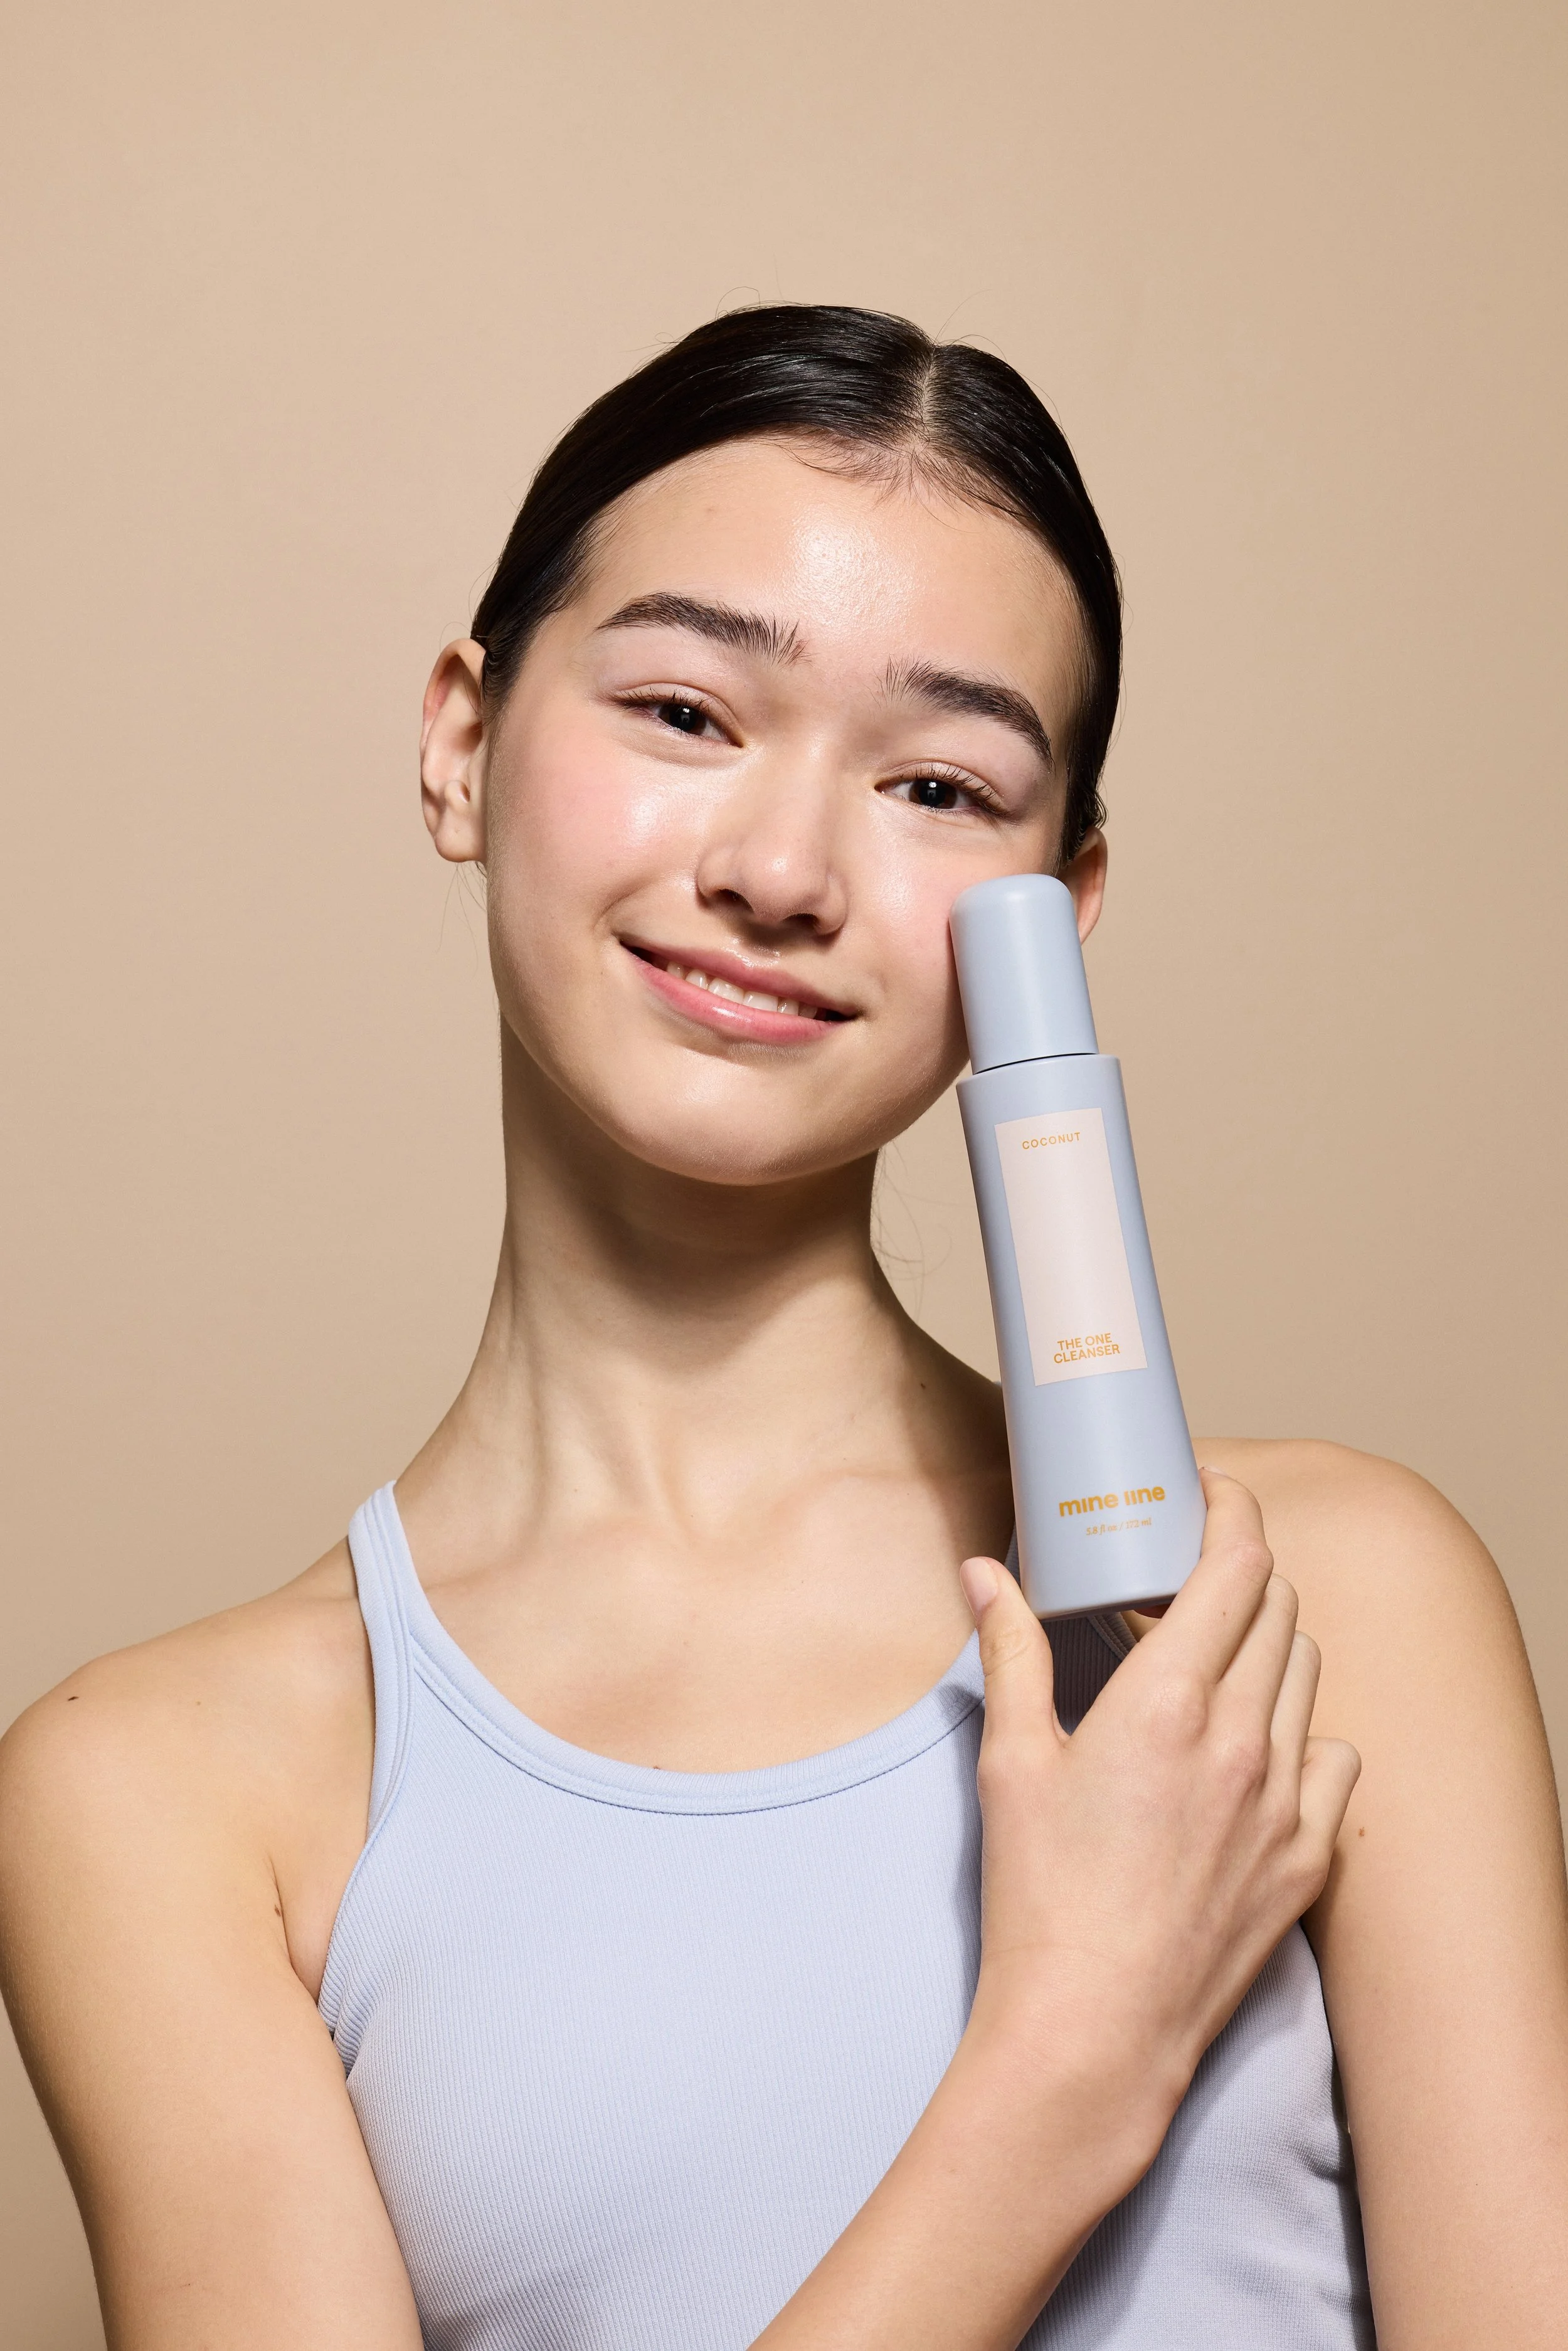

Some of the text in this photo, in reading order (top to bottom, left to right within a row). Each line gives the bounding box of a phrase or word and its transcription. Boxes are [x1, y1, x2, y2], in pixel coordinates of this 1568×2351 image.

[1022, 1132, 1080, 1149] COCONUT
[1057, 1333, 1112, 1351] THE ONE
[1054, 1344, 1120, 1364] CLEANSER
[1086, 1526, 1098, 1536] 5.8
[1099, 1524, 1105, 1535] fl
[1142, 1517, 1152, 1526] ml
